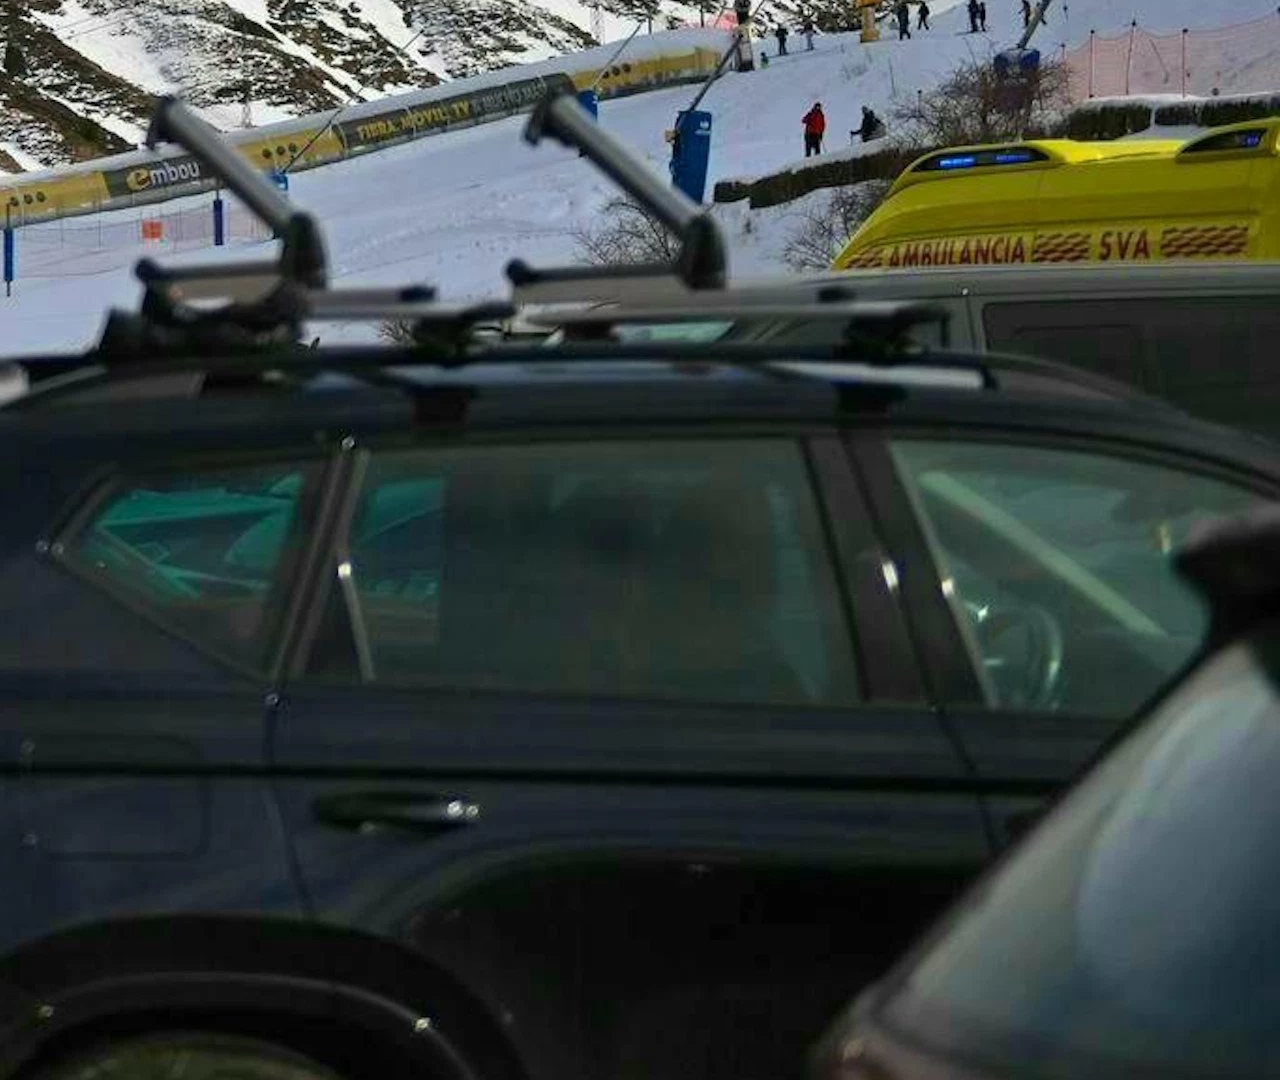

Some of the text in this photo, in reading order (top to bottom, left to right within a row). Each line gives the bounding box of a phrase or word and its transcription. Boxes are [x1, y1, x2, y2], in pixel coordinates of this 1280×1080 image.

[126, 162, 200, 192] embou
[889, 228, 1150, 267] AMBULANCIA SVA
